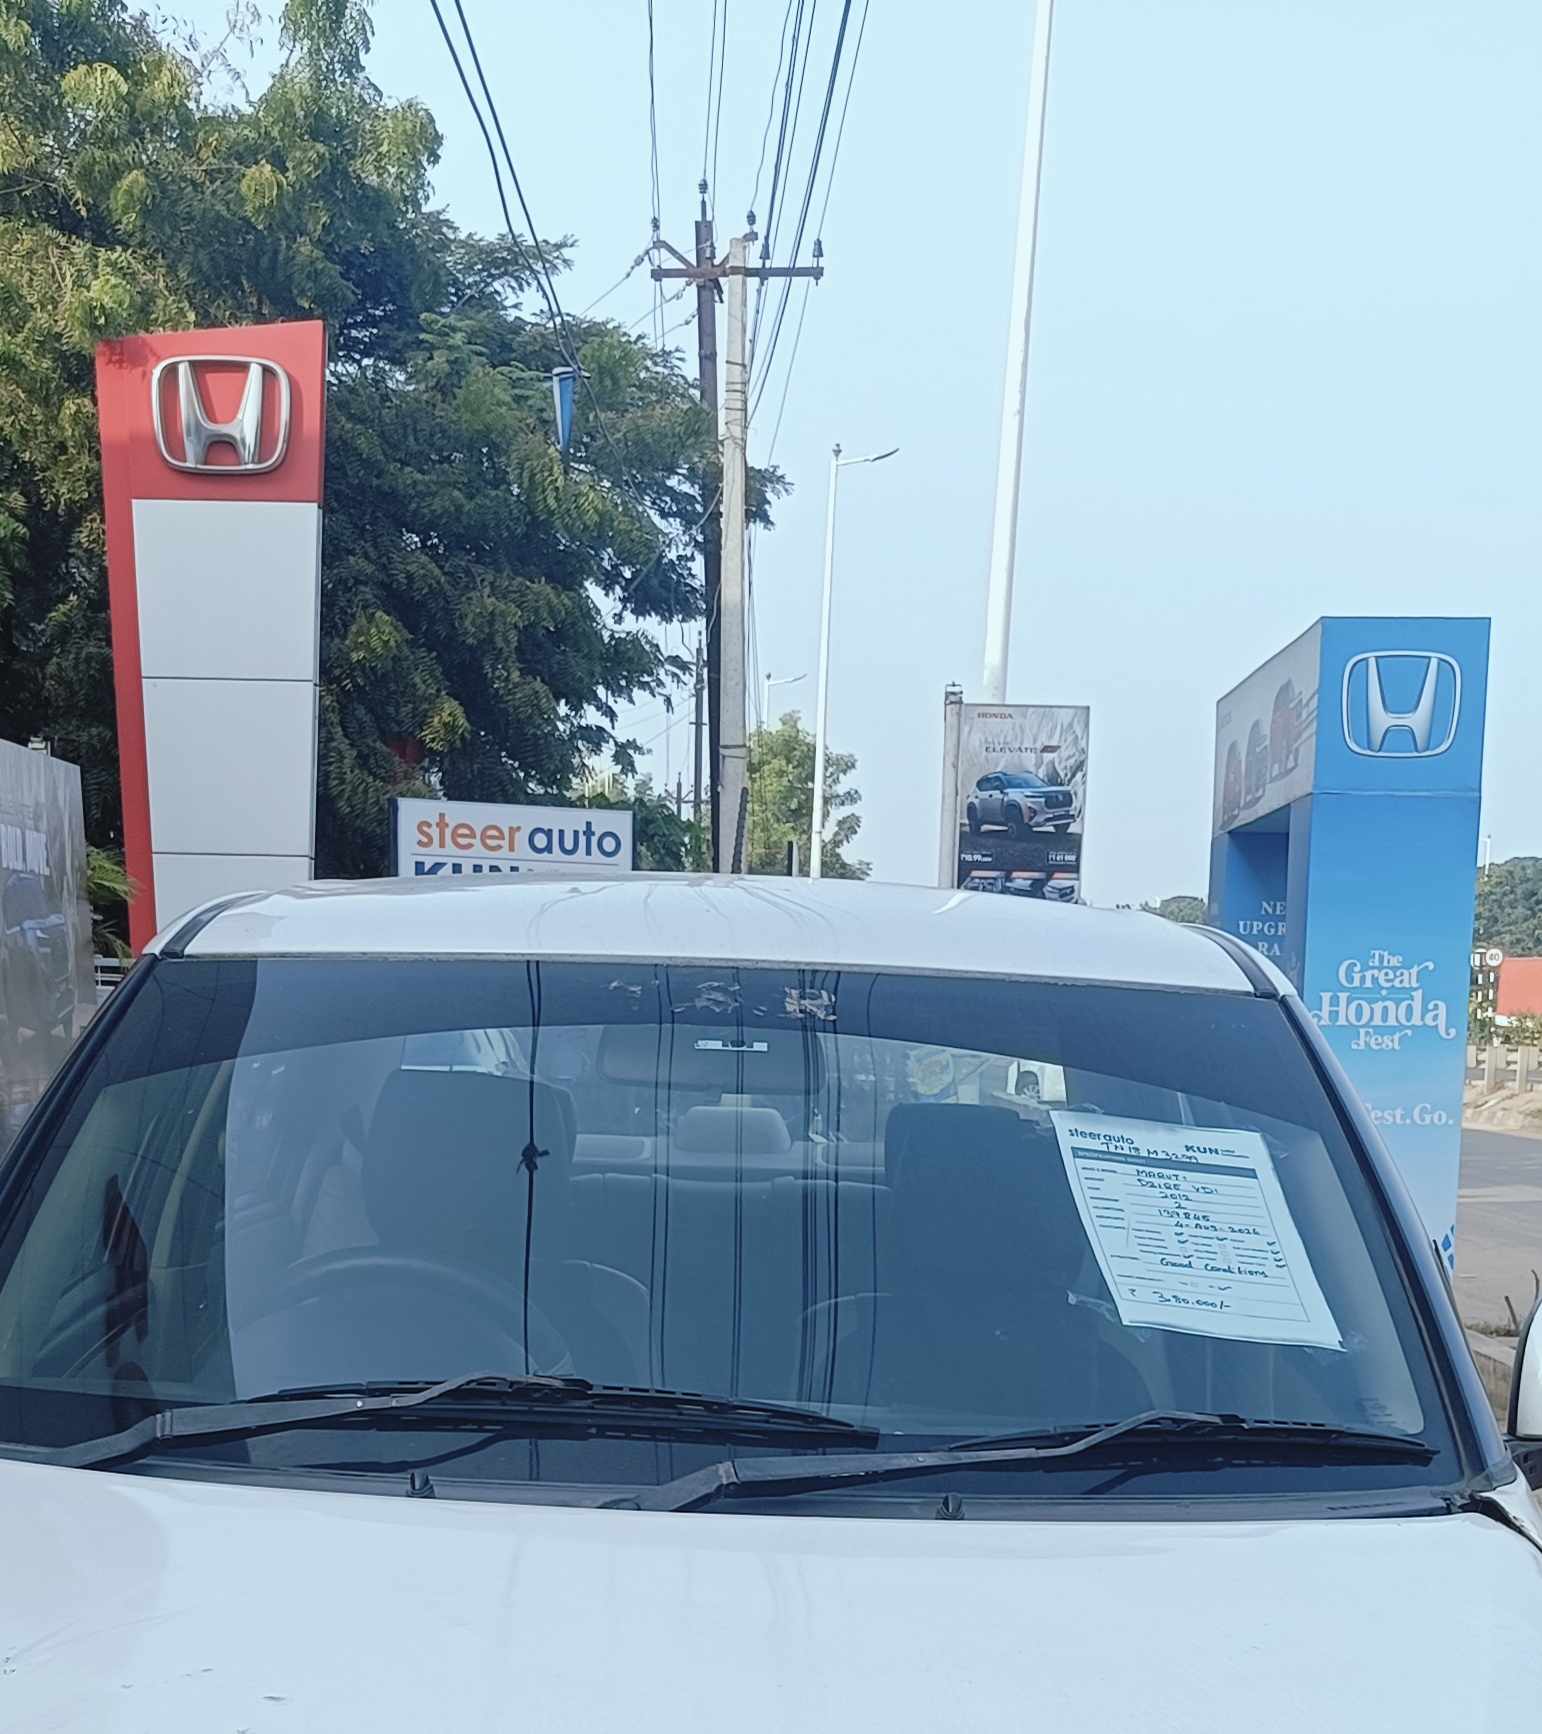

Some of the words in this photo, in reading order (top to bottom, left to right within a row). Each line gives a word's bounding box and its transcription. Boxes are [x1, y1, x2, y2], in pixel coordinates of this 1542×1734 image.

[977, 712, 1013, 720] HONDA
[985, 746, 1038, 754] ELEVATE
[1369, 950, 1403, 967] The
[1337, 959, 1435, 988] Great
[1309, 989, 1457, 1039] Honda
[1351, 1028, 1412, 1050] Fest
[1147, 1149, 1158, 1157] M
[1185, 1145, 1220, 1155] KUN
[1159, 1191, 1192, 1201] 2012
[1174, 1201, 1187, 1209] 2
[1160, 1257, 1194, 1269] Good
